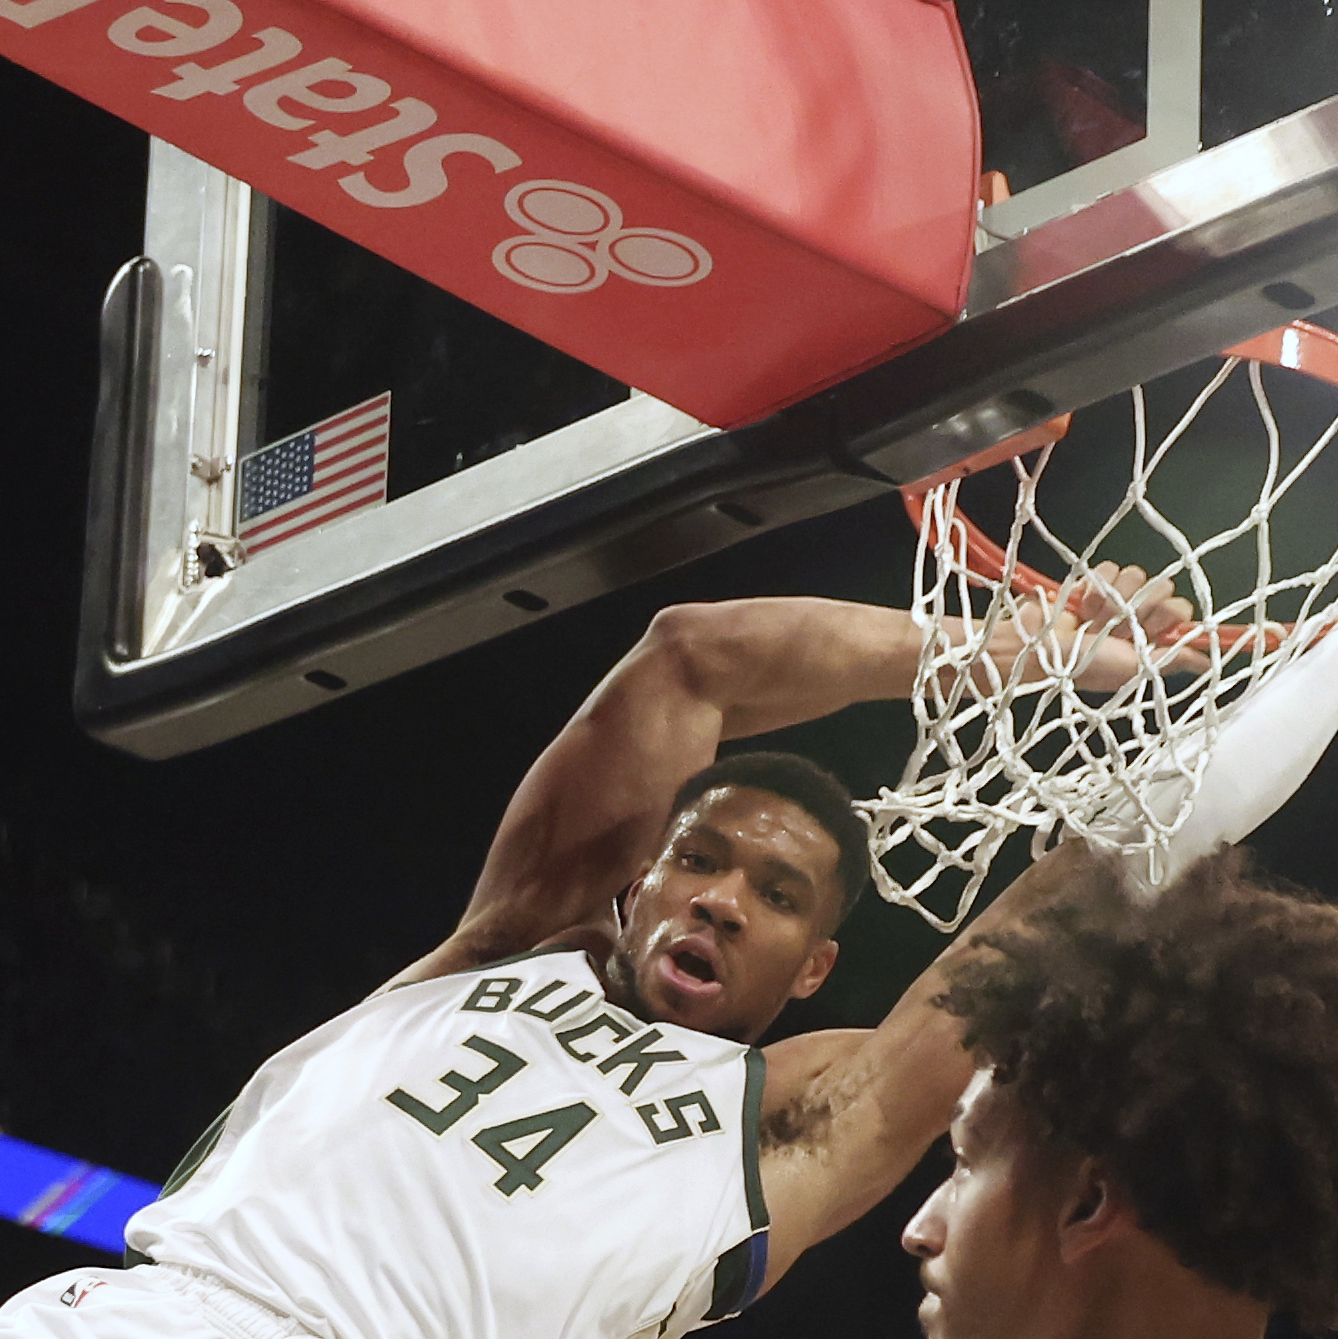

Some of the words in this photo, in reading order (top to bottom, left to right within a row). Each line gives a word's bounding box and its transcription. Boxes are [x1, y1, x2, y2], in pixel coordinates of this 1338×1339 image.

[107, 0, 524, 208] State
[384, 1034, 599, 1199] 34
[460, 976, 725, 1146] BUCKS
